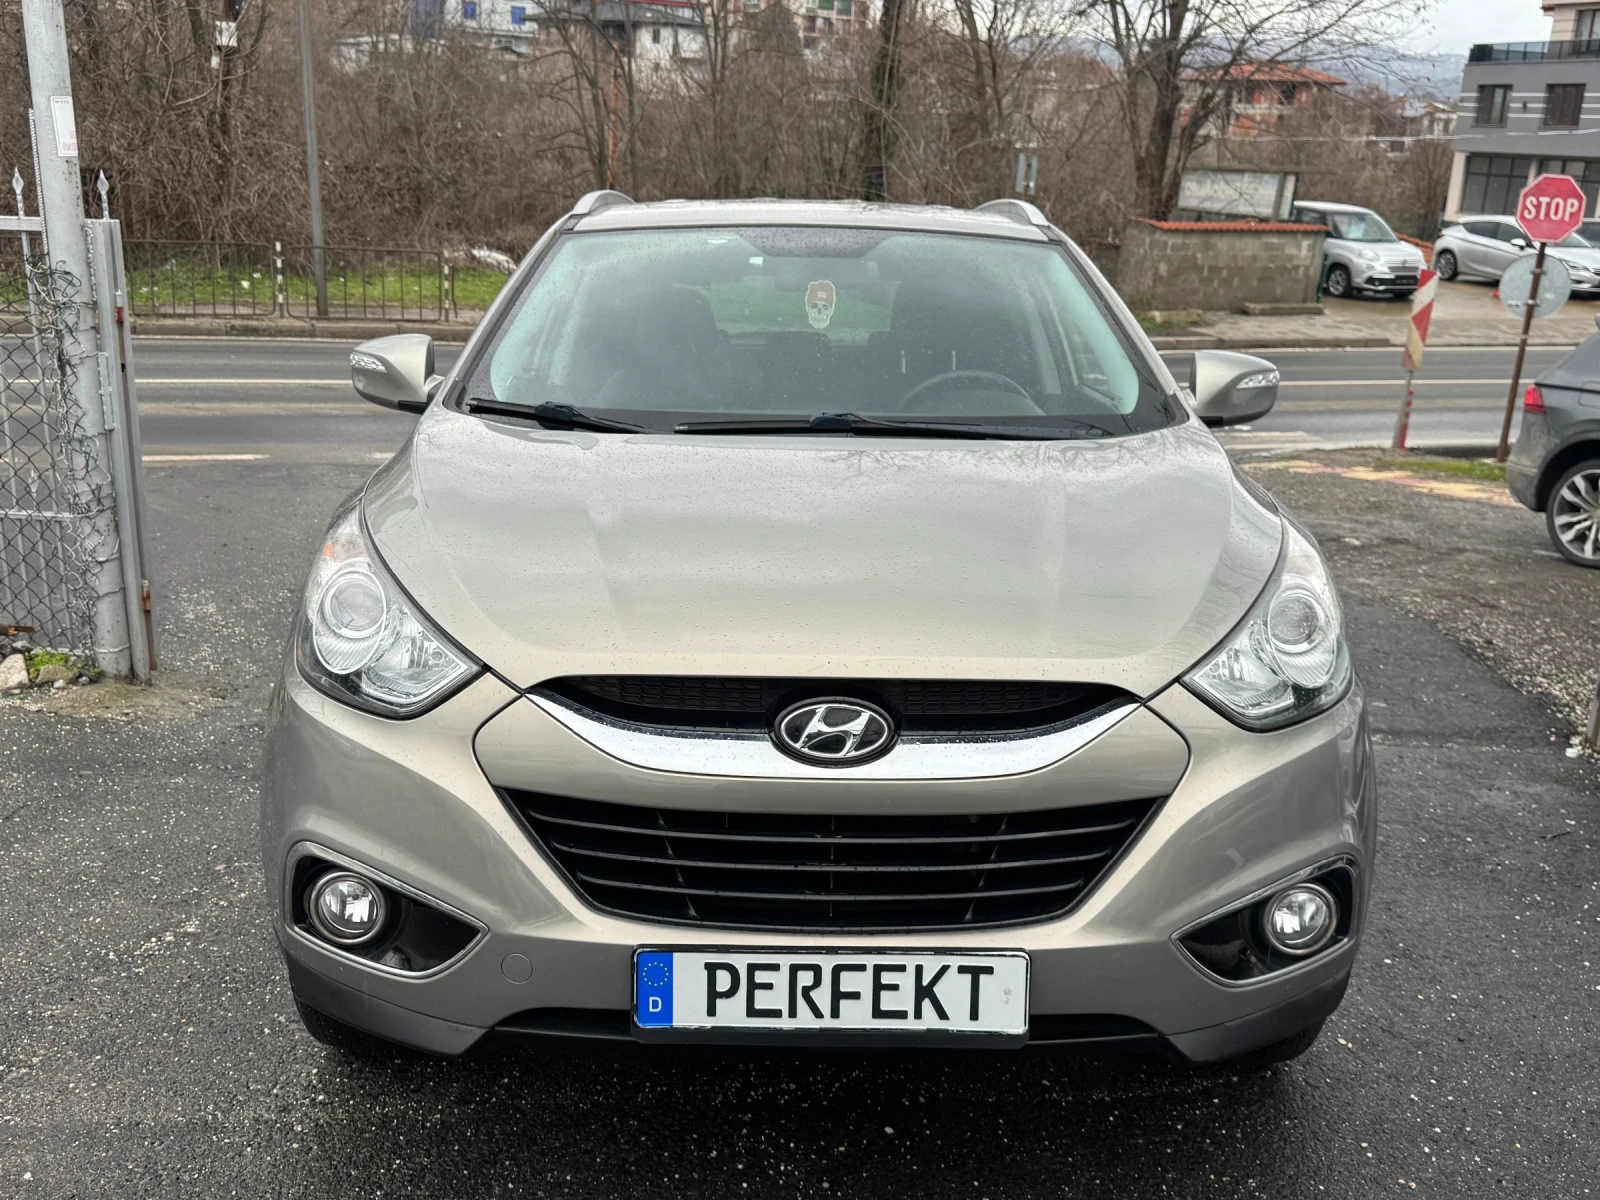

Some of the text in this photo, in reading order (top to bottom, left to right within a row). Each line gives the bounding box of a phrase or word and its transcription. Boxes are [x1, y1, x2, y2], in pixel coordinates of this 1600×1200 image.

[1523, 195, 1579, 222] STOP
[648, 996, 662, 1012] D
[704, 961, 994, 1021] PERFEKT
